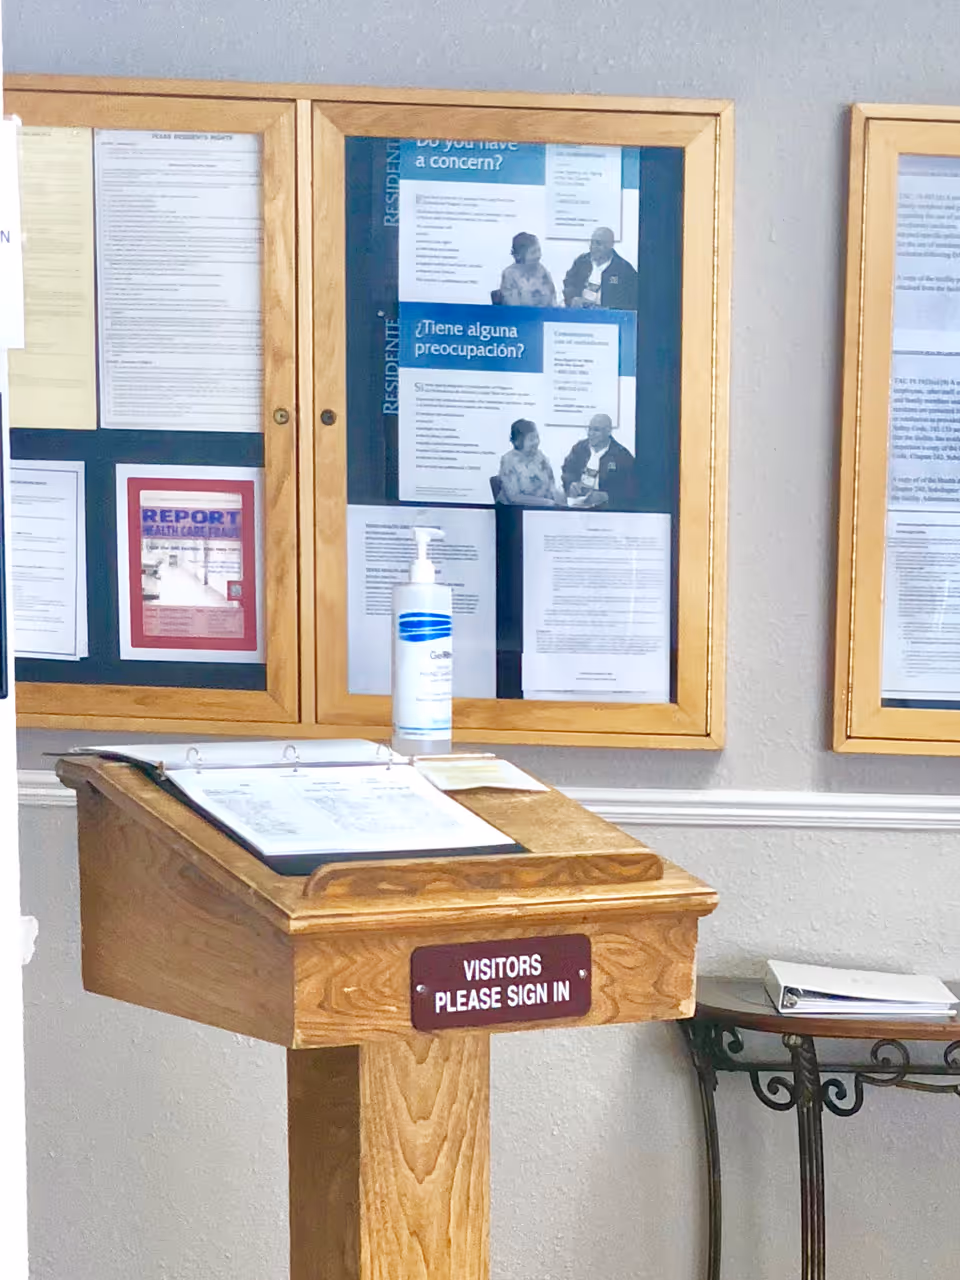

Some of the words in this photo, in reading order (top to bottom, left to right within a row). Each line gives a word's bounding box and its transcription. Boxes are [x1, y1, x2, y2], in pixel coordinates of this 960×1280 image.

[415, 156, 425, 168] a
[430, 154, 503, 170] concern?
[415, 319, 463, 338] ¿Tiene
[467, 321, 518, 341] alguna
[415, 342, 525, 360] preocupación?
[142, 508, 240, 524] REPORT
[464, 954, 542, 981] VISITORS
[435, 987, 502, 1013] PLEASE
[507, 982, 548, 1008] SIGN
[553, 980, 570, 1002] IN
